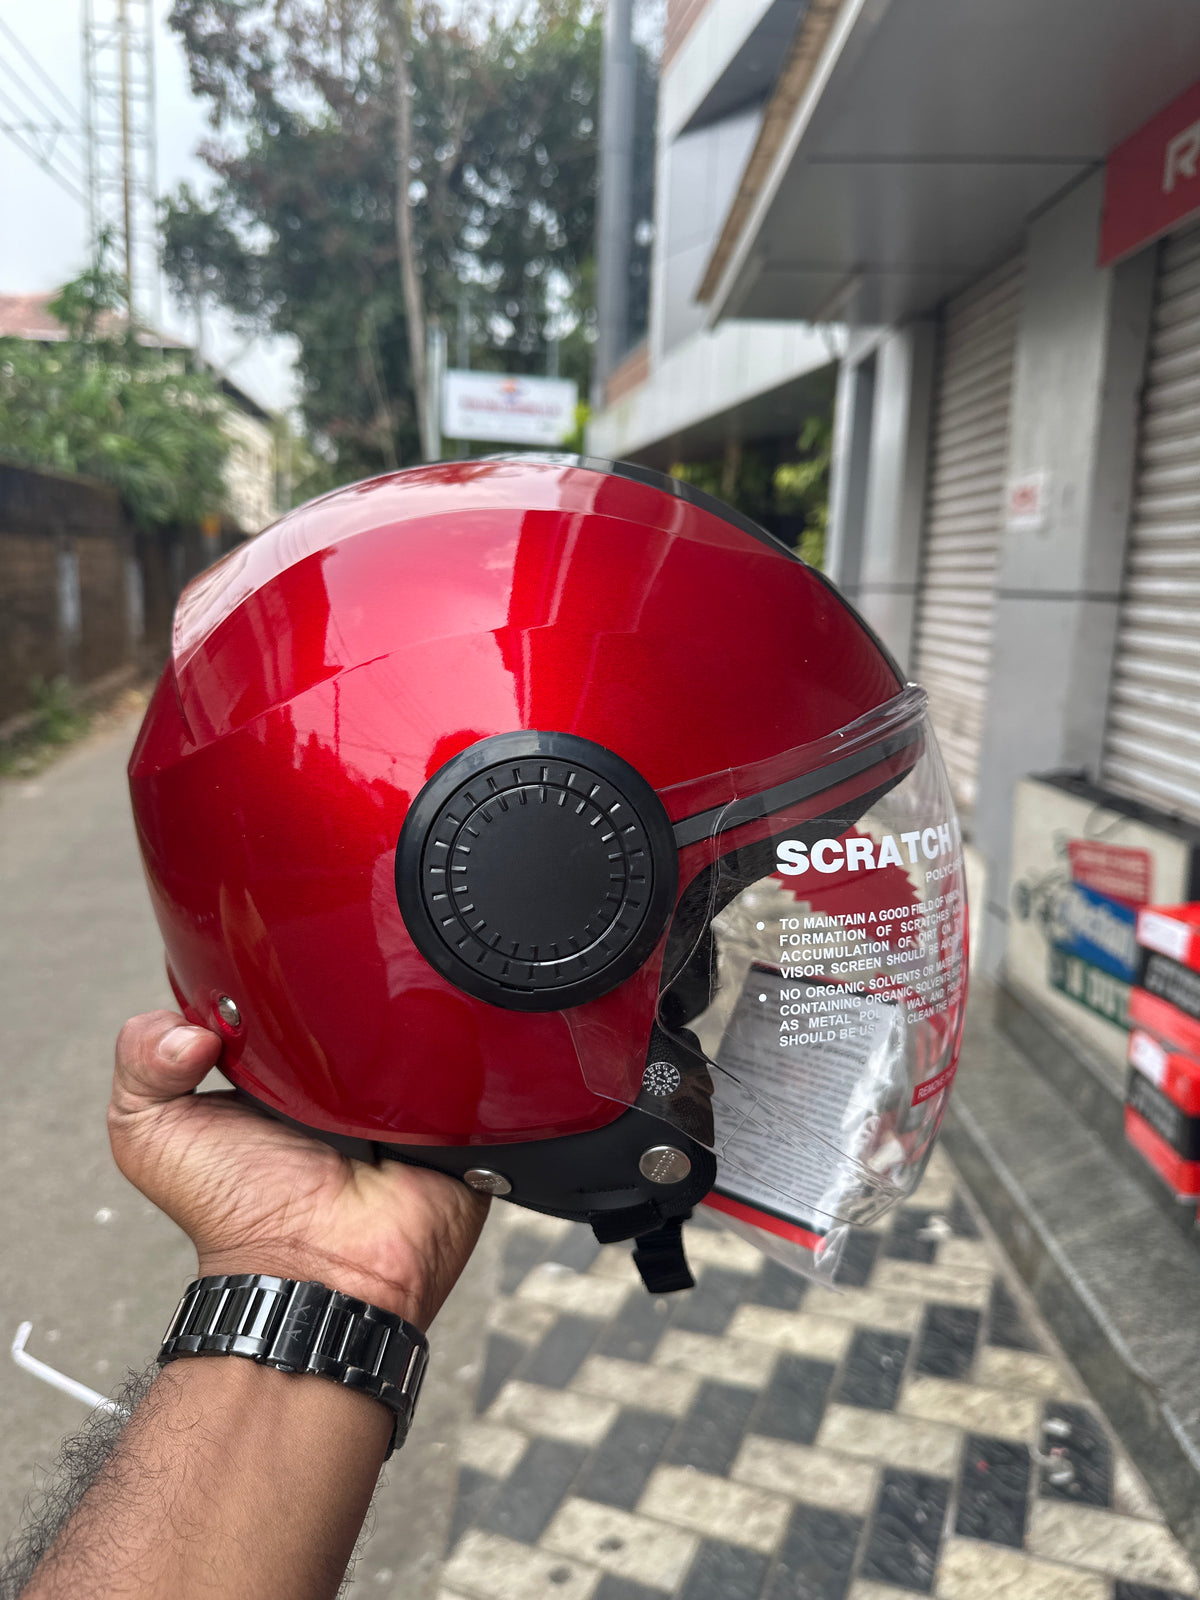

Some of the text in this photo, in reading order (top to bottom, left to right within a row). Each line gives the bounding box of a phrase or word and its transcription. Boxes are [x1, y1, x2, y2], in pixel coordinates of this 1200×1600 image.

[776, 822, 951, 876] SCRATCH
[779, 918, 800, 930] TO
[803, 912, 866, 929] MAINTAIN
[868, 911, 877, 923] A
[879, 906, 910, 921] GOOD
[911, 899, 934, 916] FIELD
[935, 895, 944, 908] OF
[779, 928, 866, 947] FORMATION
[876, 924, 893, 937] OF
[900, 908, 951, 933] SCRATCHES
[779, 939, 890, 963] ACCUMULATION
[898, 936, 912, 948] OF
[918, 927, 938, 943] DIRT
[942, 922, 951, 935] ON
[780, 964, 825, 979] VISOR
[830, 957, 882, 975] SCREEN
[886, 947, 926, 966] SHOULD
[928, 942, 939, 956] BE
[780, 988, 801, 1001] NO
[806, 980, 865, 998] ORGANIC
[869, 968, 920, 990] SOLVENTS
[922, 964, 934, 977] OR
[780, 997, 861, 1017] CONTAINING
[865, 985, 913, 1006] ORGANIC
[915, 970, 951, 994] SOLVENTS
[779, 1019, 799, 1032] AS
[808, 1013, 852, 1029] METAL
[907, 994, 927, 1010] WAX
[929, 988, 944, 1004] AND
[779, 1030, 836, 1048] SHOULD
[839, 1027, 857, 1040] BE
[907, 1006, 934, 1025] CLEAN
[935, 999, 947, 1014] THE
